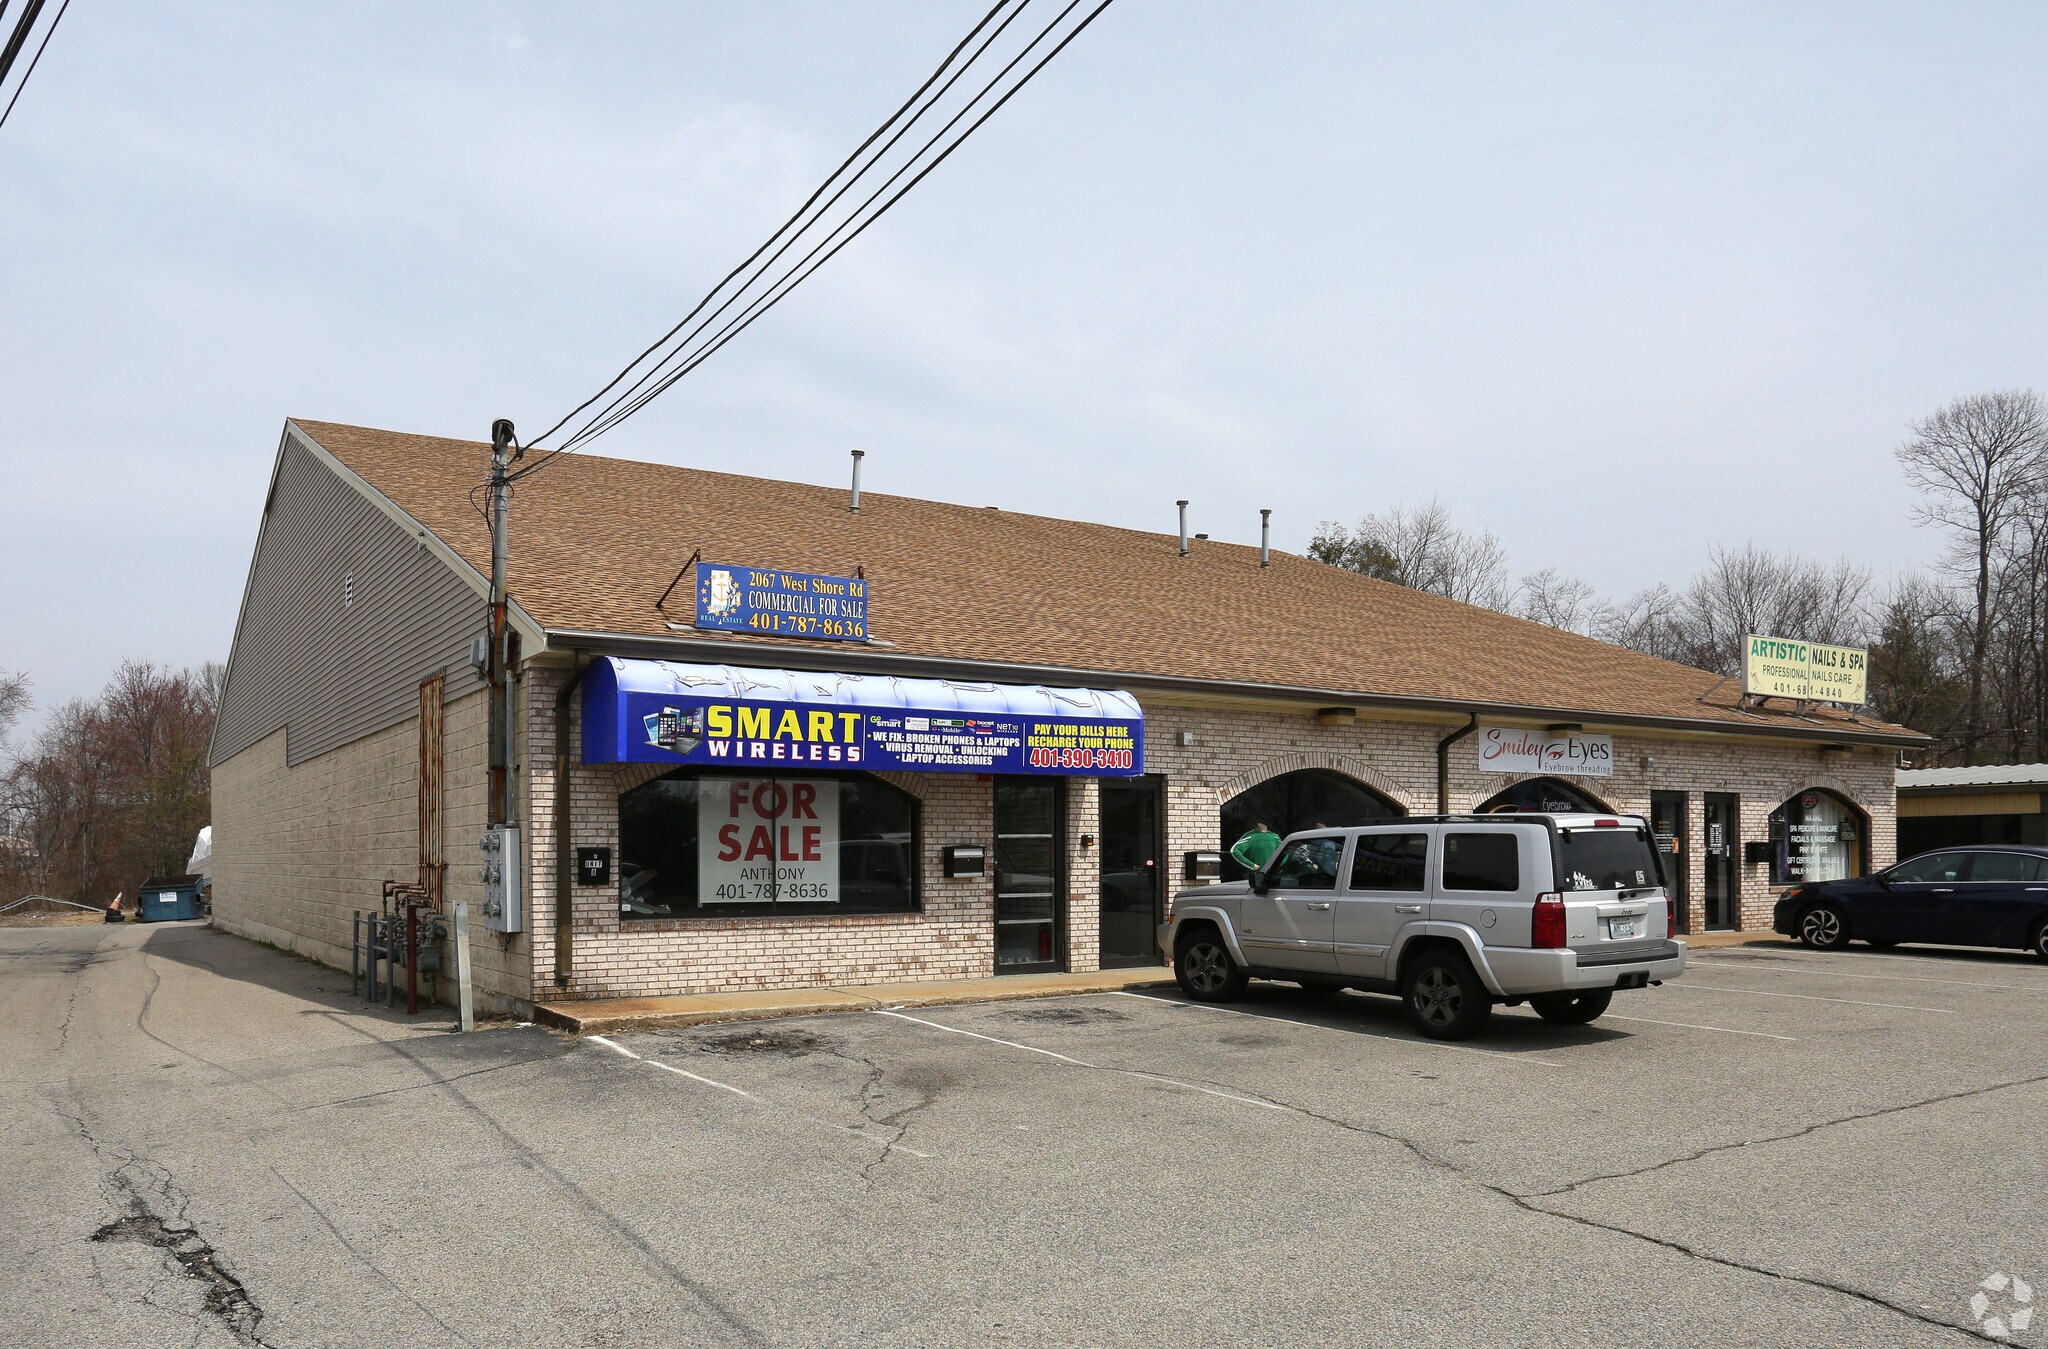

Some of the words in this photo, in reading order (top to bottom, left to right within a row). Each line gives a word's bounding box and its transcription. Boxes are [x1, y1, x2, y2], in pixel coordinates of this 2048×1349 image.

[749, 572, 776, 587] 2067
[781, 574, 808, 592] West
[812, 578, 844, 596] Shore
[850, 582, 863, 598] Rd
[748, 591, 815, 614] COMMERCIAL
[818, 598, 838, 616] FOR
[841, 600, 864, 618] SALE
[748, 612, 864, 638] 401-787-8636
[1751, 639, 1807, 662] ARTISTIC
[1812, 648, 1837, 668] NAILS
[1840, 652, 1846, 668] &
[1848, 653, 1864, 671] SPA
[1762, 664, 1808, 680] PROFESSIONAL
[1812, 670, 1832, 682] NAILS
[1834, 672, 1852, 684] CARE
[707, 705, 861, 744] SMART
[876, 719, 901, 728] smart
[1034, 724, 1051, 736] PAY
[1052, 724, 1078, 736] YOUR
[1080, 726, 1104, 737] BILLS
[1106, 726, 1128, 738] HERE
[873, 732, 888, 742] WE
[888, 732, 904, 742] FIX:
[906, 734, 941, 744] BROKEN
[942, 734, 974, 746] PHONES
[976, 738, 982, 746] &
[984, 737, 1020, 747] LAPTOPS
[886, 742, 913, 752] VIRUS
[914, 743, 954, 754] REMOVAL
[961, 745, 1008, 756] UNLOCKING
[1028, 736, 1076, 748] RECHARGE
[1078, 738, 1103, 748] YOUR
[1105, 738, 1134, 750] PHONE
[1484, 728, 1545, 770] Smiley
[1568, 738, 1610, 765] Eyes
[708, 740, 860, 762] WIRELESS
[901, 753, 935, 764] LAPTOP
[935, 754, 993, 766] ACCESSORIES
[1030, 748, 1132, 770] 401-390-3410
[1544, 762, 1574, 772] Eyebrow
[1577, 764, 1611, 776] threading
[730, 780, 818, 820] FOR
[1542, 798, 1570, 812] Eyebrow
[718, 824, 822, 862] SALE
[740, 868, 805, 880] ANTHONY
[716, 883, 828, 899] 401-787-8636
